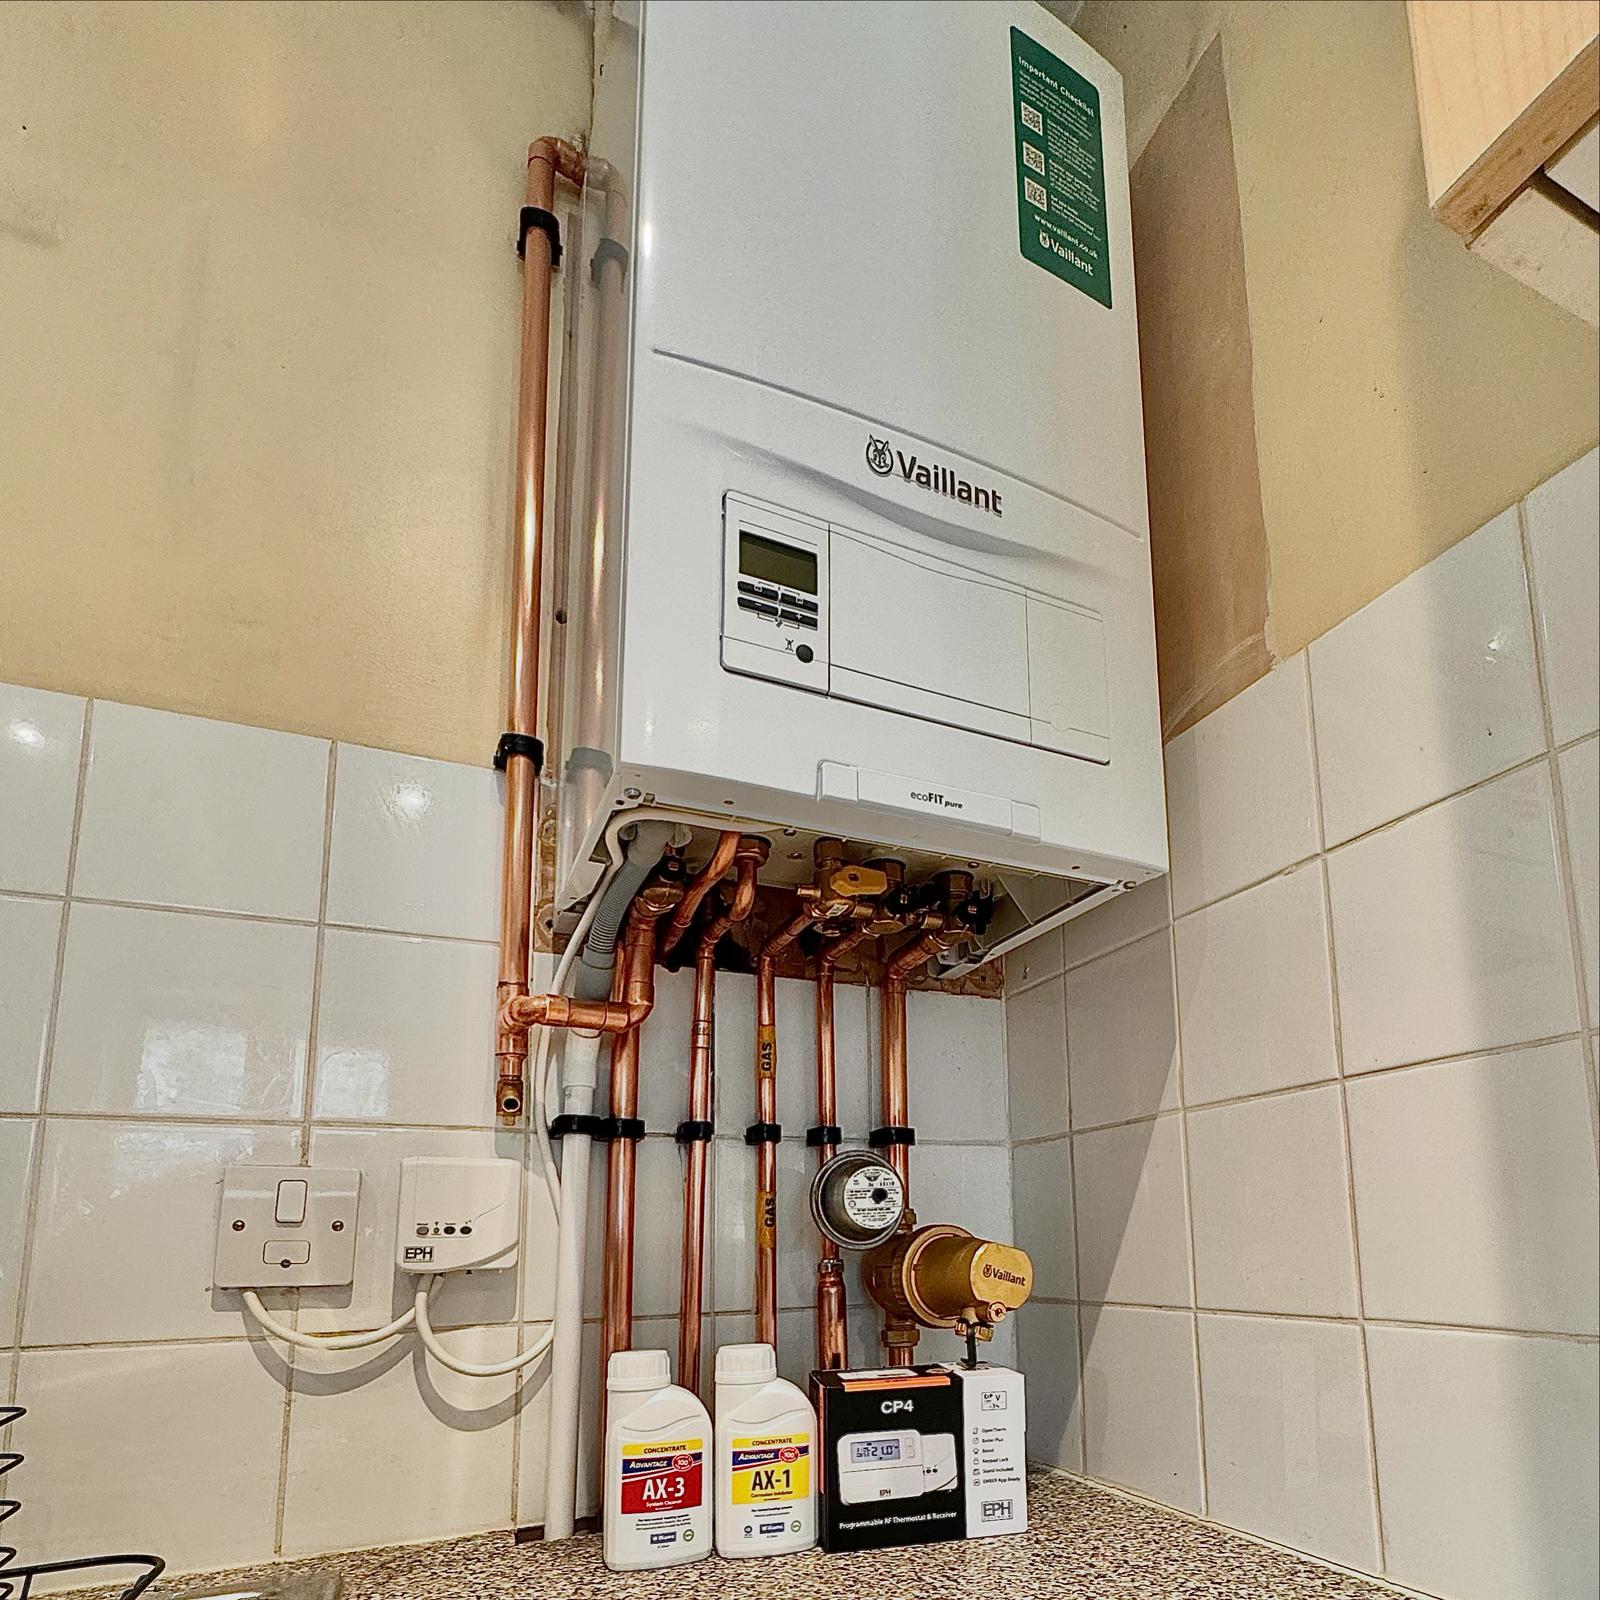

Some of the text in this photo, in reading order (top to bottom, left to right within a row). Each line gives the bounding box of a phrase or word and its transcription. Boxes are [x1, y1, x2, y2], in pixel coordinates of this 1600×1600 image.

[1018, 56, 1058, 89] Important
[1060, 86, 1094, 117] Checklist
[1034, 214, 1098, 259] www.vaillant.co.uk
[1051, 238, 1094, 276] Vaillant
[897, 450, 1002, 515] Vaillant
[910, 791, 963, 809] ecoFIT pure
[761, 1042, 772, 1072] GAS
[764, 1197, 776, 1228] GAS
[405, 1247, 433, 1260] EPH
[993, 1267, 1026, 1287] Vaillant
[880, 1399, 914, 1414] CP4
[643, 1445, 687, 1454] CONCENTRATE
[752, 1438, 792, 1446] CONCENTRATE
[642, 1477, 685, 1500] AX-3
[751, 1469, 790, 1491] AX-1
[982, 1501, 1011, 1517] EPH
[839, 1518, 883, 1530] Programmable
[893, 1514, 926, 1523] Thermostat
[932, 1511, 957, 1519] Receiver
